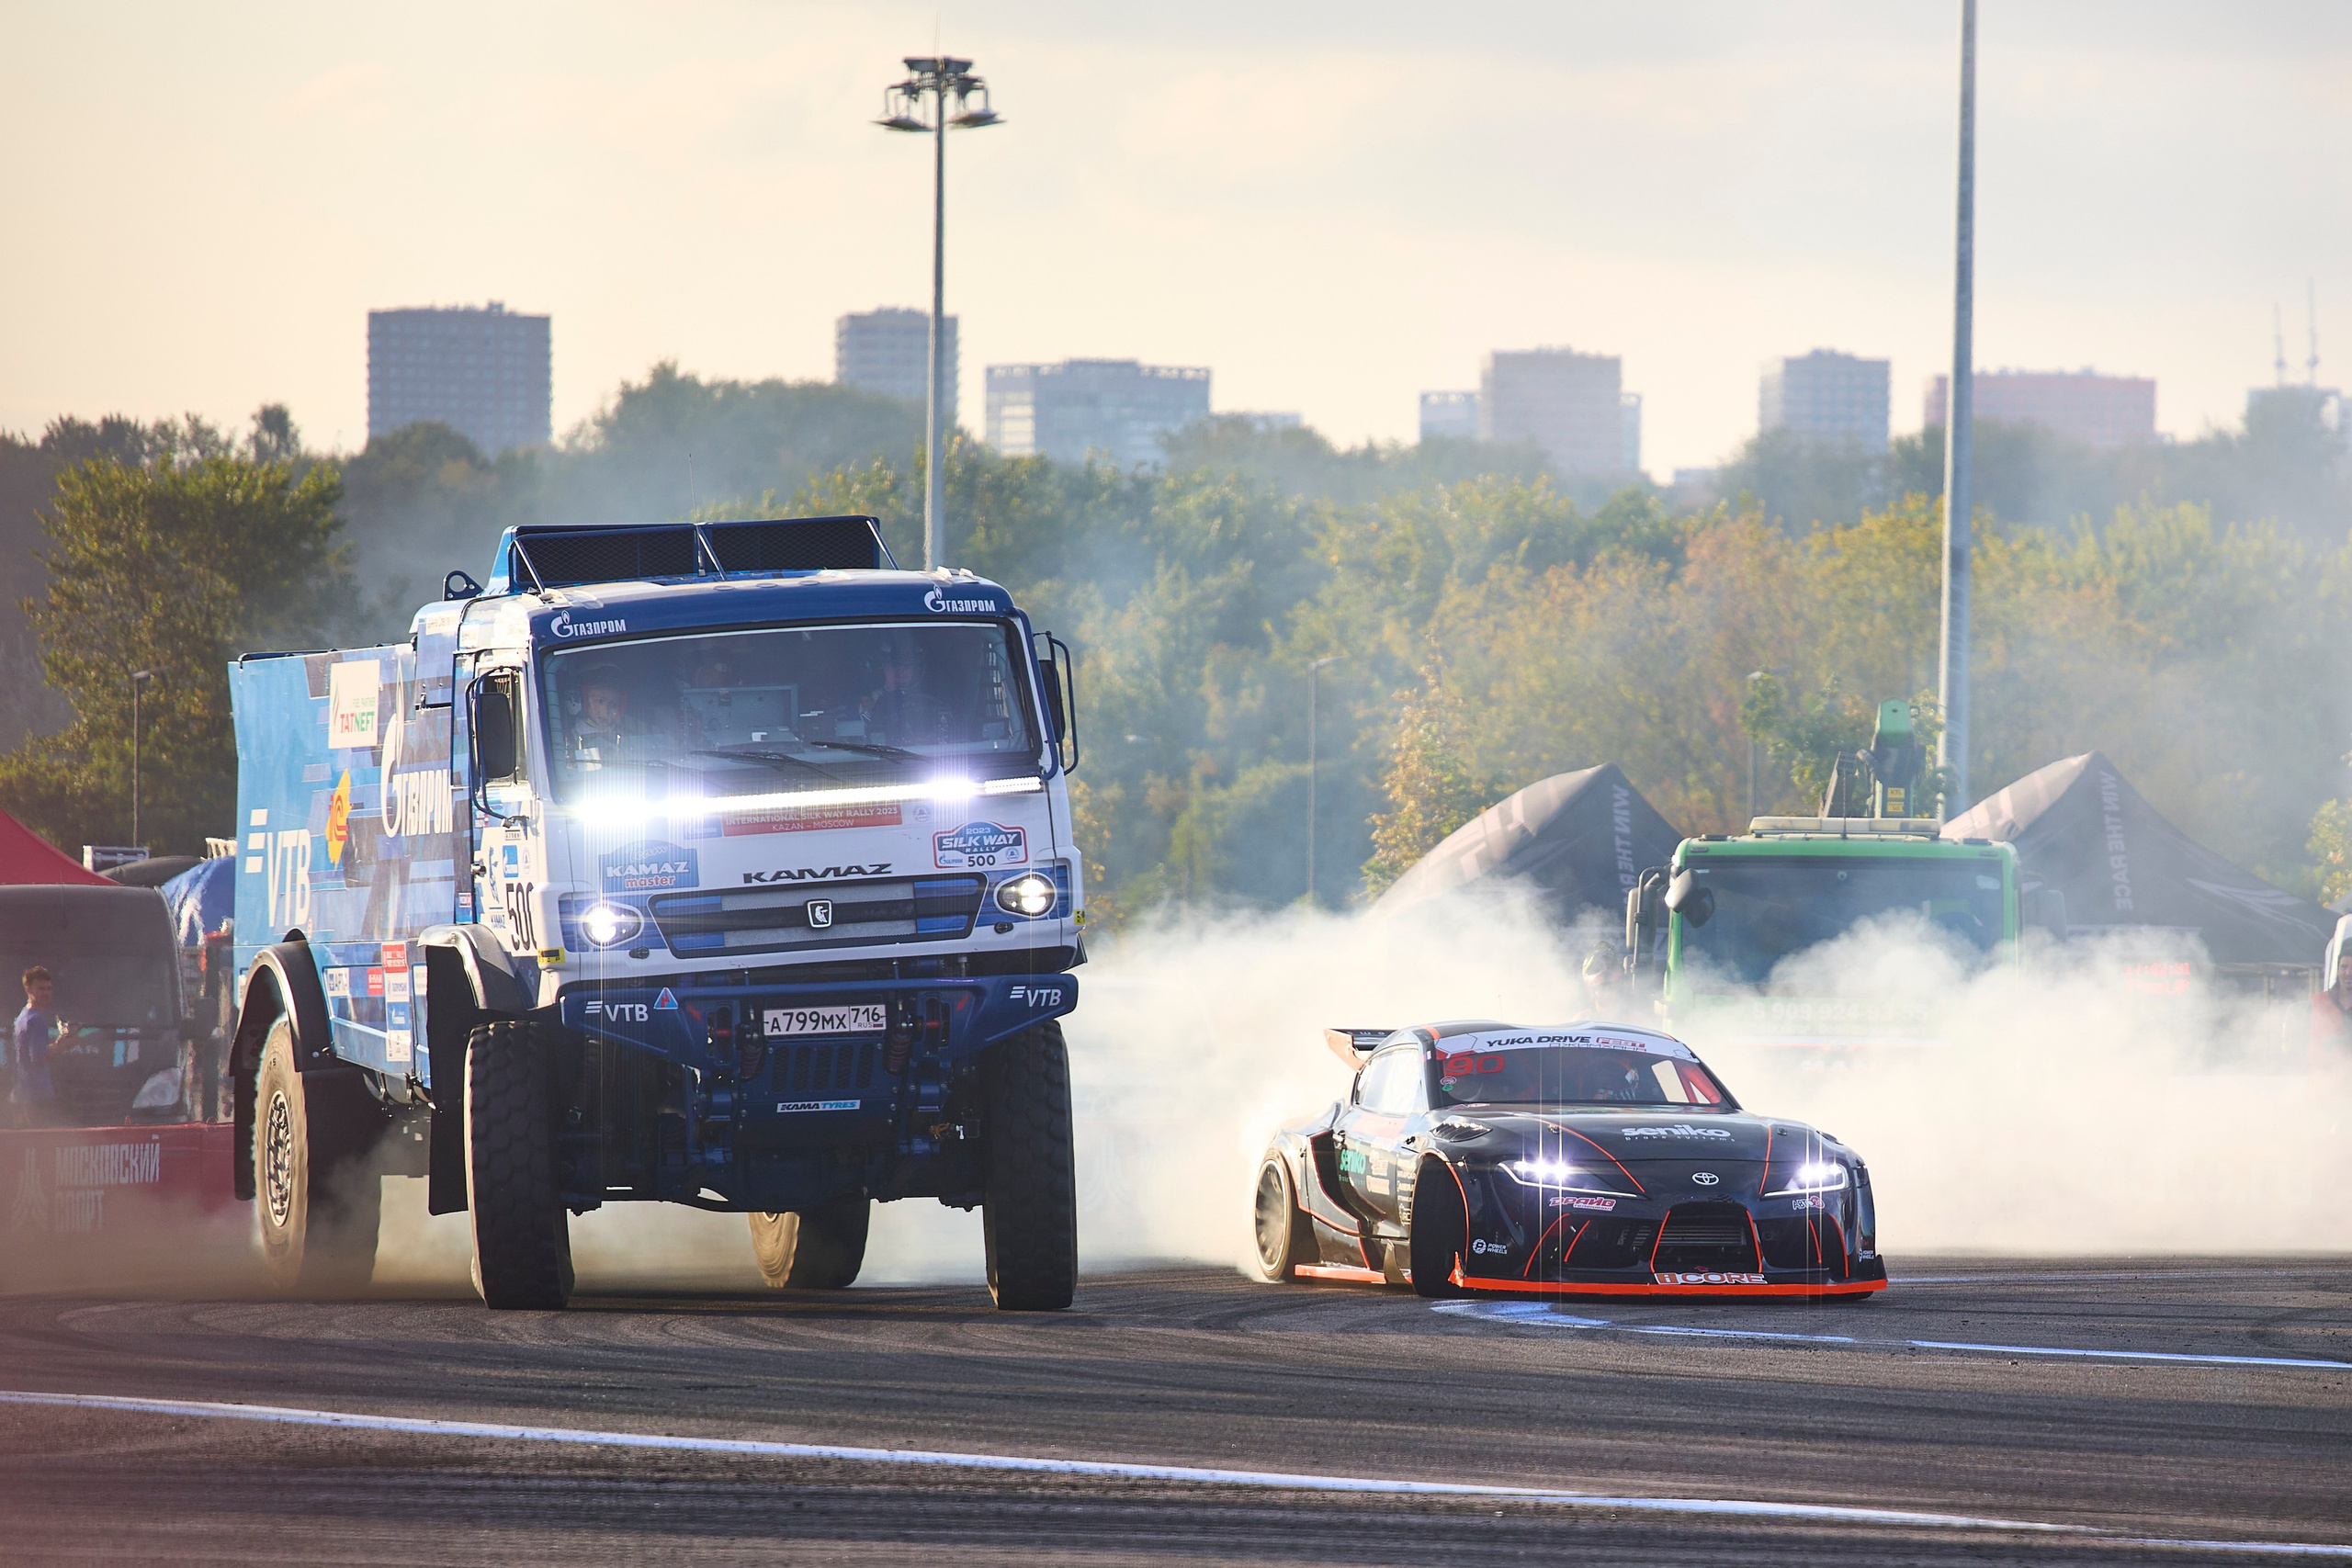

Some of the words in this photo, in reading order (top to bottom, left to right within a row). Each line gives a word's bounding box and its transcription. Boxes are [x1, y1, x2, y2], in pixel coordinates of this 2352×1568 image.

[945, 600, 996, 612] ГАЗПРОМ
[573, 619, 627, 637] ГАЗПРОМ
[340, 712, 375, 734] TATNEFT
[726, 813, 799, 825] INTERNATIONAL
[802, 812, 820, 820] SILK
[823, 810, 843, 818] WAY
[847, 808, 874, 817] RALLY
[1611, 783, 1630, 834] WIN
[772, 822, 804, 831] KAZAN
[813, 818, 854, 829] MOSCOW
[967, 827, 991, 835] 2023
[942, 835, 980, 849] SILK
[983, 833, 1018, 846] WAY
[2104, 814, 2126, 853] THE
[967, 854, 996, 868] 500
[1615, 834, 1634, 873] THE
[606, 861, 690, 878] KAMAZ
[742, 863, 893, 884] KAMAZ
[267, 829, 311, 928] VTB
[626, 874, 675, 888] master
[2109, 854, 2134, 911] RACE
[1026, 988, 1062, 1008] VTB
[604, 1004, 649, 1022] VTB
[851, 1007, 881, 1023] 716
[1487, 1036, 1533, 1047] YUKA
[1536, 1035, 1591, 1043] DRIVE
[1598, 1038, 1645, 1047] FEST
[1447, 1055, 1505, 1076] 90
[781, 1102, 820, 1111] KAMA
[821, 1100, 857, 1109] TYRES
[1622, 1123, 1731, 1137] seniko
[55, 1134, 160, 1187] МОСКОВСКИЙ
